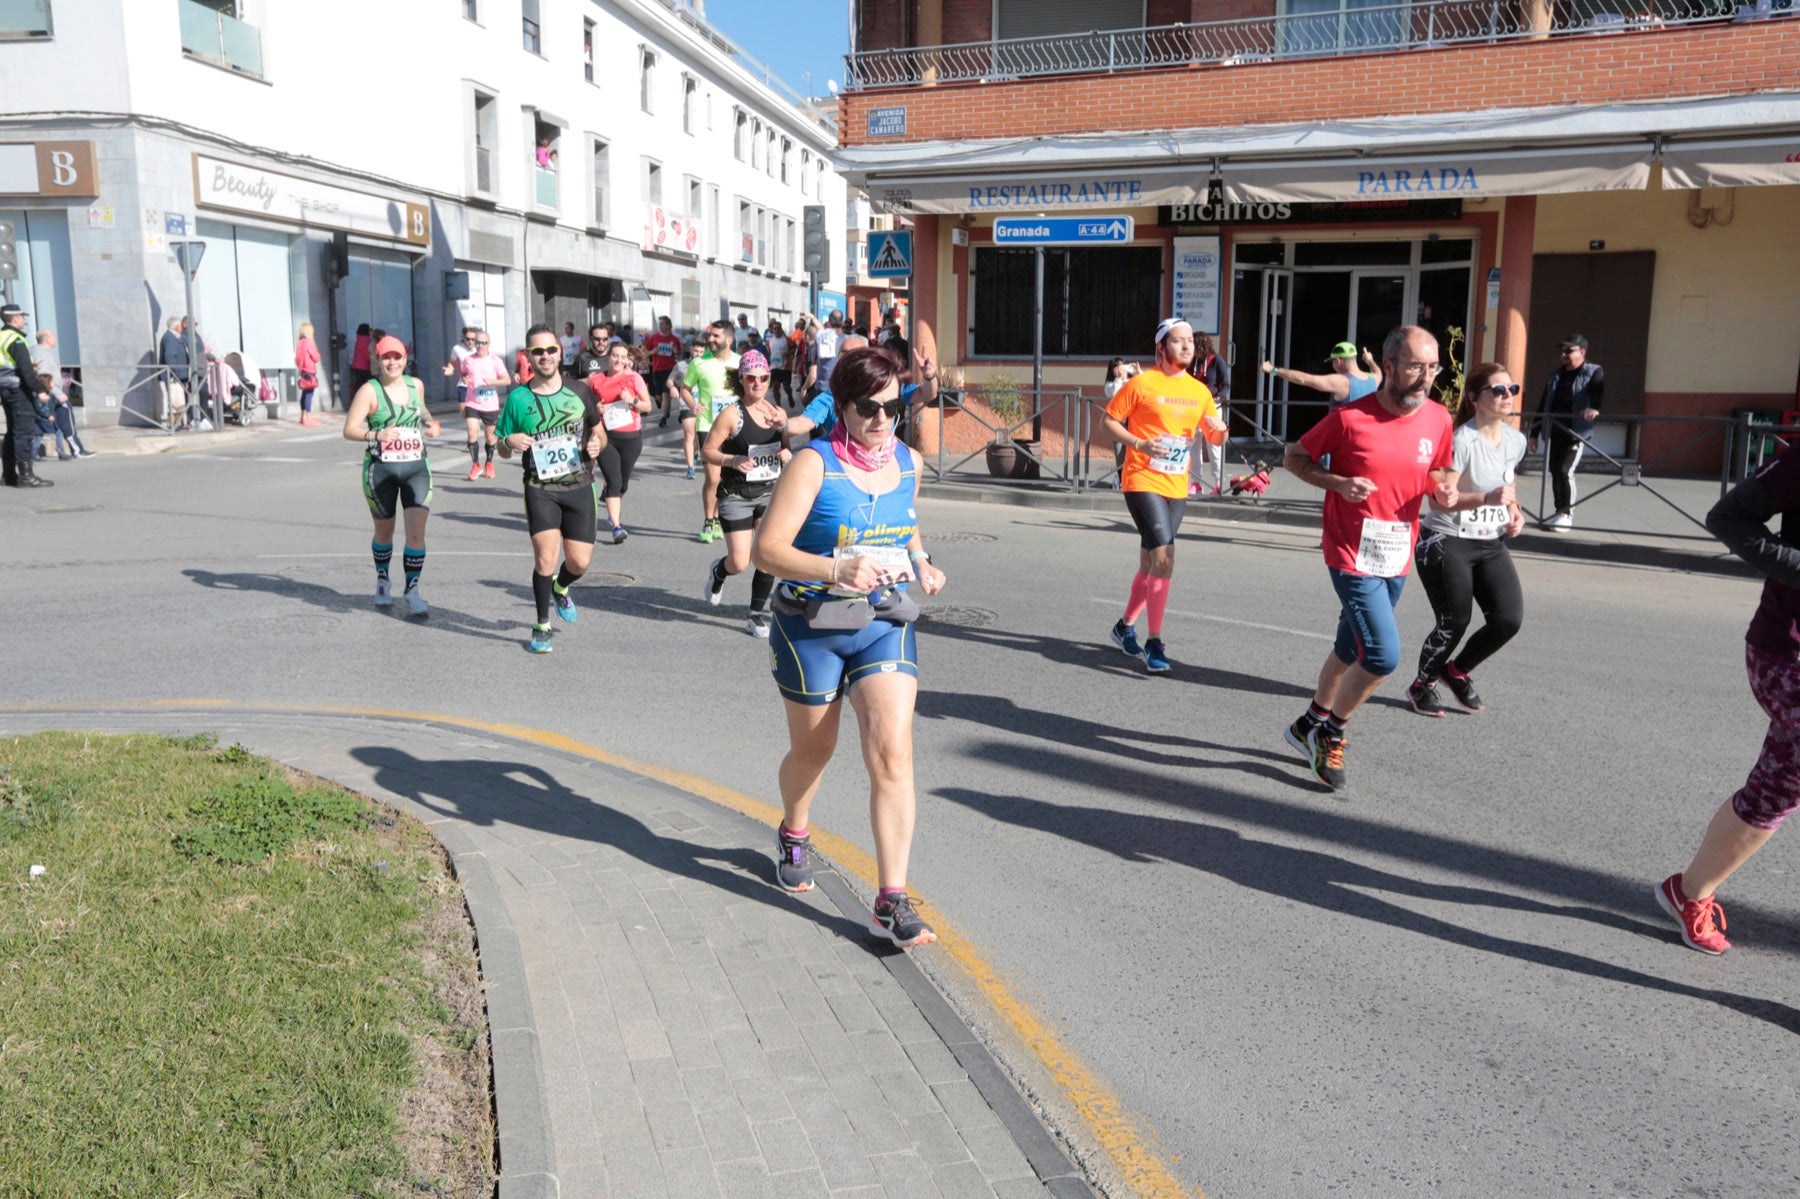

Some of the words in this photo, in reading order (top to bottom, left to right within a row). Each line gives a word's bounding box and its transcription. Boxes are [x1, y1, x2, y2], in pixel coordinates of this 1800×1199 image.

[877, 108, 904, 117] AVENIDA
[879, 116, 902, 126] JACOBO
[870, 124, 904, 135] CAMARERO
[50, 150, 78, 186] B
[1356, 167, 1480, 194] PARADA
[212, 165, 277, 210] Beauty
[288, 195, 308, 209] THE
[313, 199, 340, 215] SHOP
[968, 180, 1143, 208] RESTAURANTE
[1170, 202, 1292, 221] BICHITOS
[412, 210, 425, 237] B
[997, 225, 1050, 238] Granada
[1079, 225, 1106, 236] A-44
[384, 438, 421, 451] 2069
[547, 447, 568, 465] 26
[752, 454, 780, 468] 3095
[1468, 507, 1506, 522] 3178
